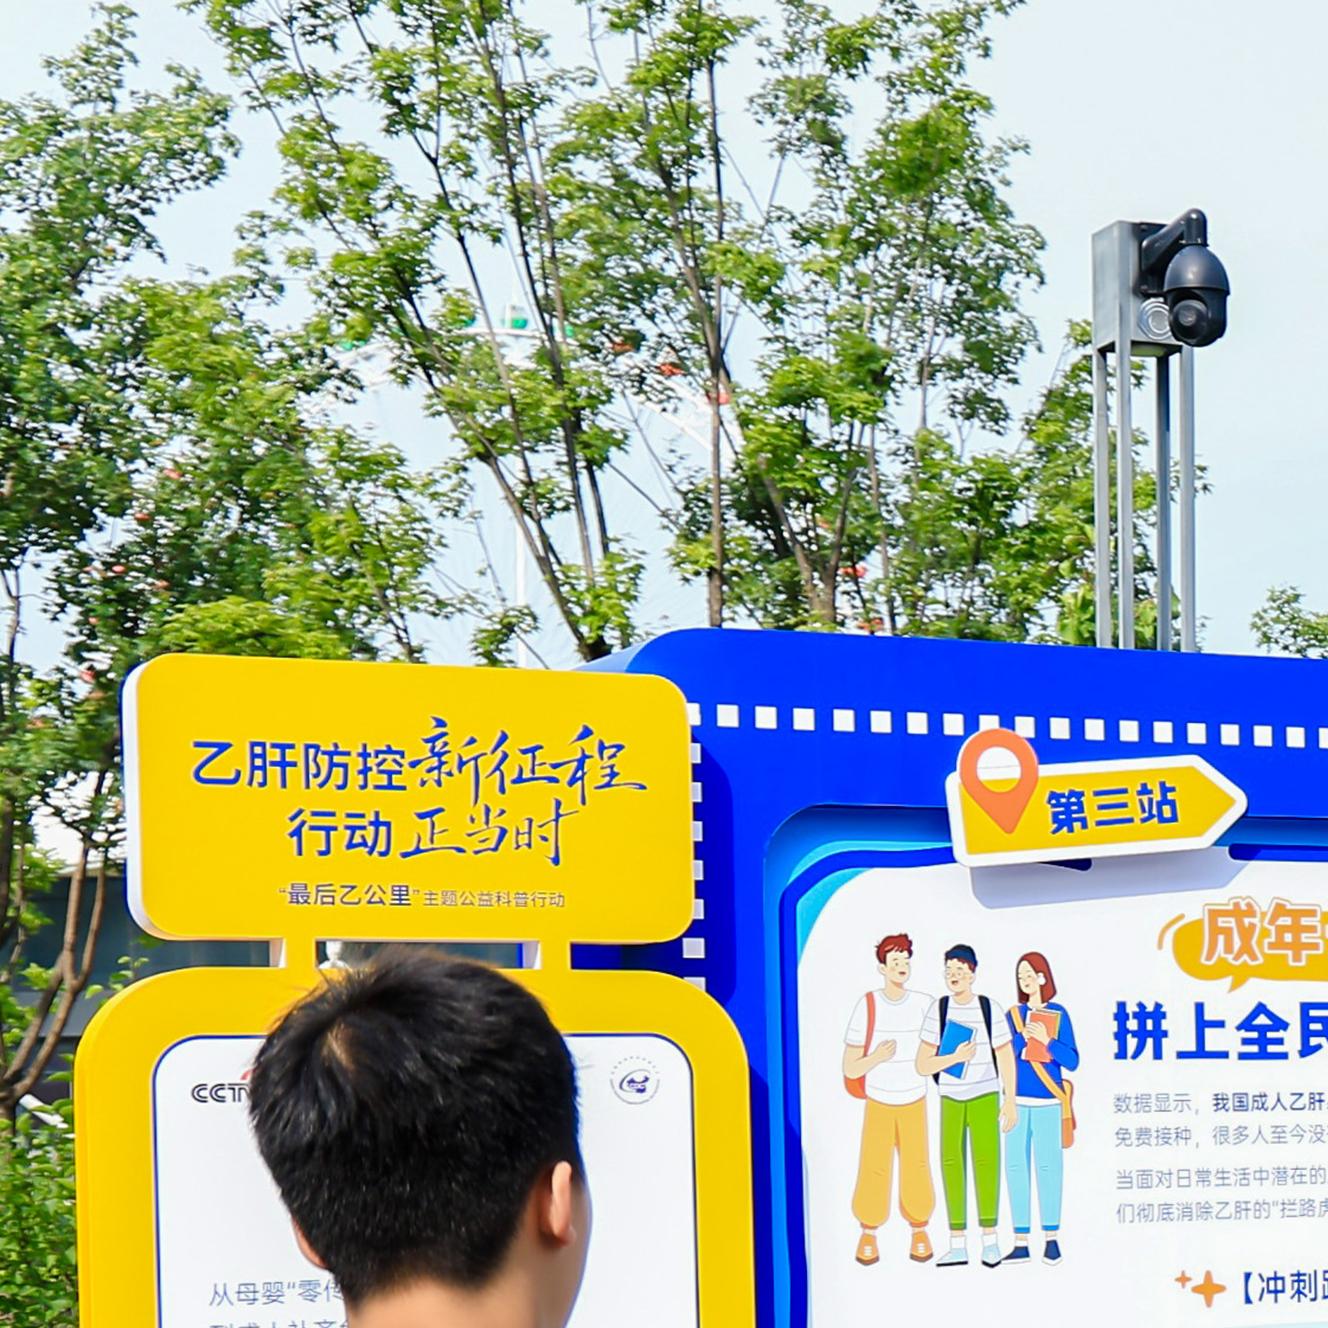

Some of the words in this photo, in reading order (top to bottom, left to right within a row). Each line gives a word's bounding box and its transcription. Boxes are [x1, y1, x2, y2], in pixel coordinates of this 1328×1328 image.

[190, 715, 648, 806] 乙肝防控新征程
[287, 797, 578, 866] 行动正当时
[1045, 780, 1180, 836] 第三站
